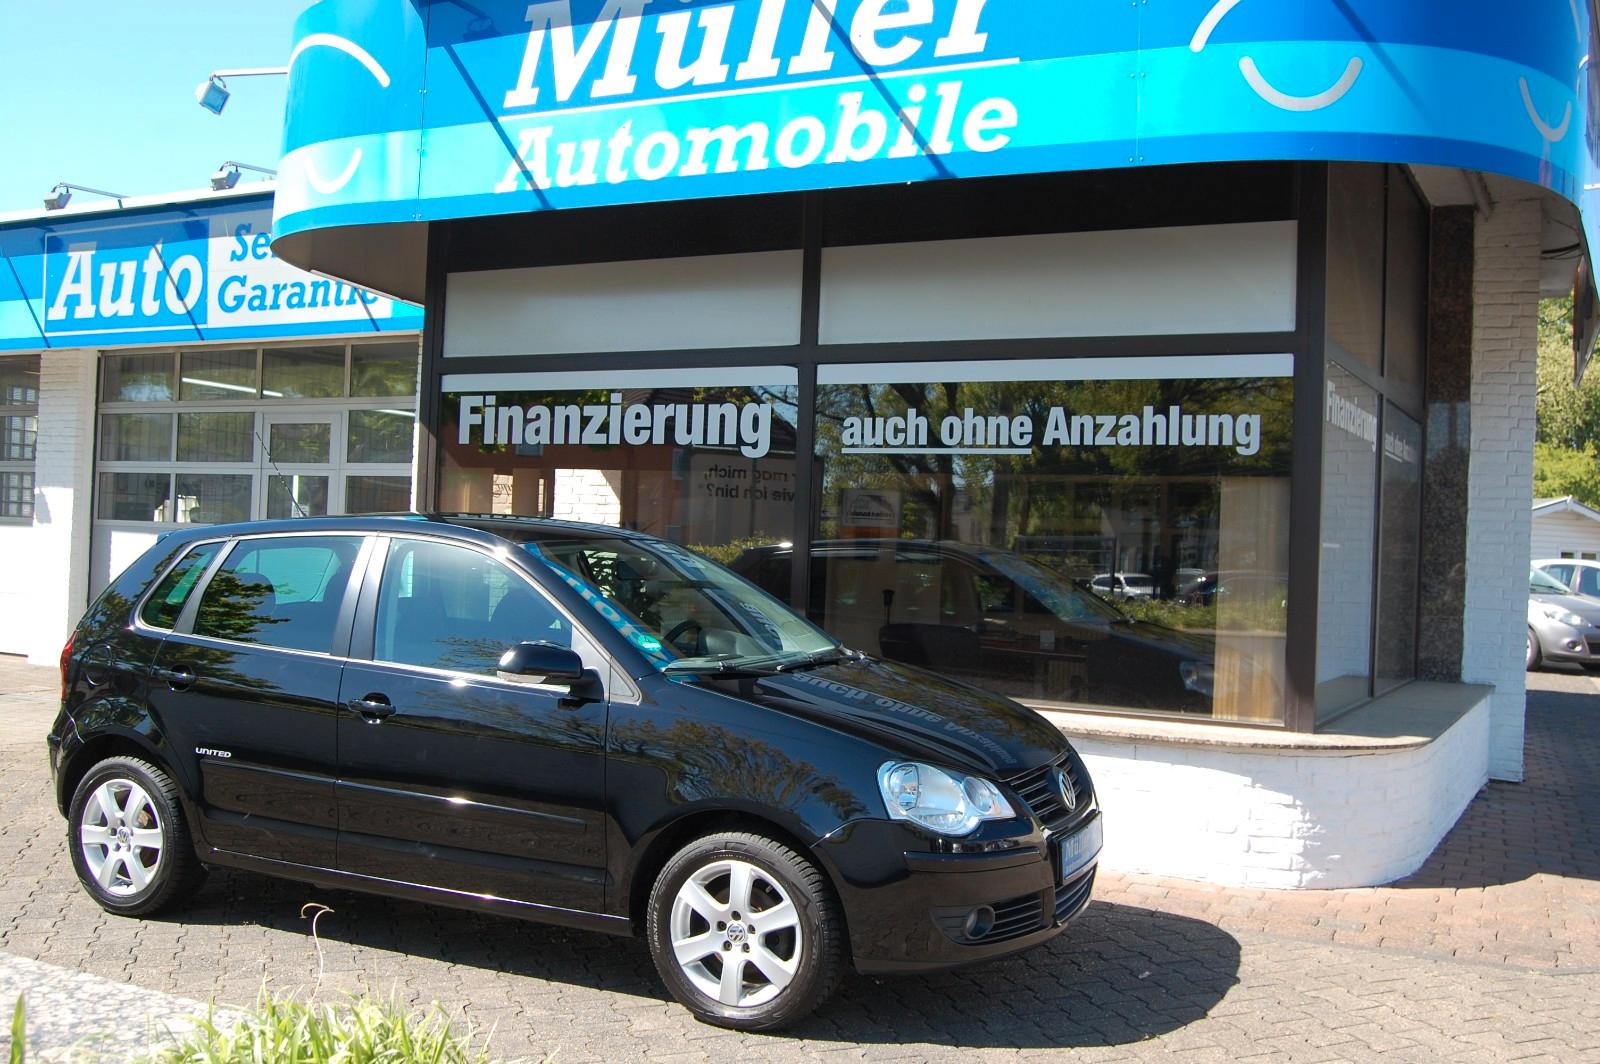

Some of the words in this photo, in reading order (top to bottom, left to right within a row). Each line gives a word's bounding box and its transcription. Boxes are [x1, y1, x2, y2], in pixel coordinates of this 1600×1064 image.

[502, 0, 991, 109] Müller
[494, 81, 1019, 193] Automobile
[47, 237, 204, 321] Auto
[458, 392, 772, 458] Finanzierung
[842, 408, 928, 446] auch
[940, 408, 1033, 446] ohne
[1043, 405, 1261, 456] Anzahlung
[195, 747, 232, 758] UNITED
